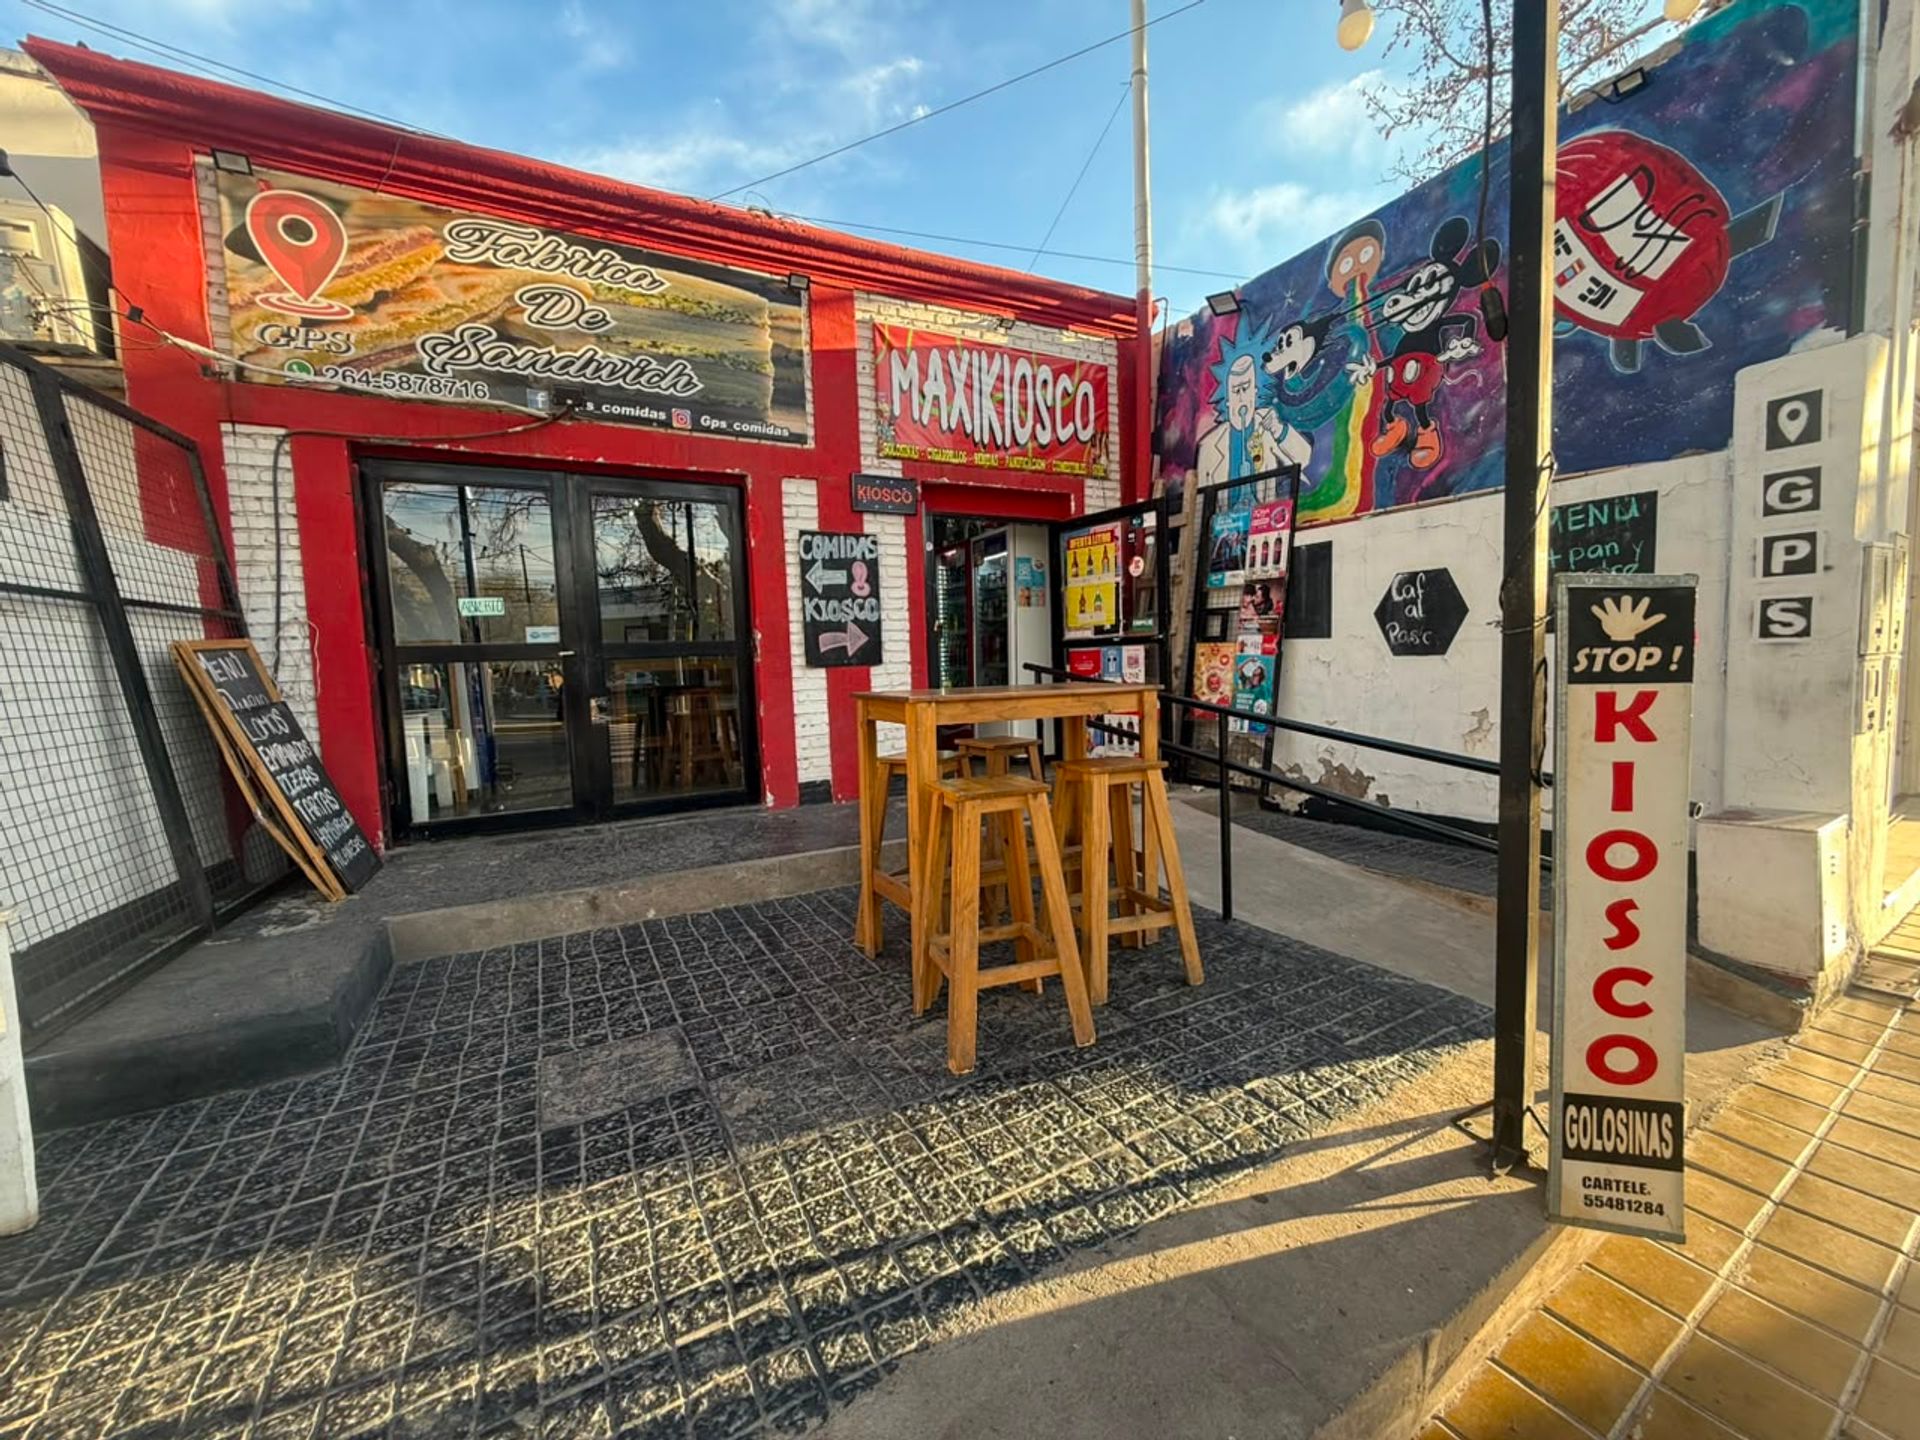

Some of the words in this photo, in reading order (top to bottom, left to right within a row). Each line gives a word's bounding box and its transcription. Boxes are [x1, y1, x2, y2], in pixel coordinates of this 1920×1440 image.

[1578, 164, 1718, 280] Duff
[443, 219, 670, 293] Fabrica
[515, 283, 617, 331] De
[254, 323, 356, 357] GPS
[418, 324, 703, 396] Sandwich
[889, 347, 1096, 449] MAXIKIOSCO
[700, 414, 790, 438] Gps_comidas
[857, 484, 914, 504] KIOSCO
[800, 535, 878, 560] COMIDAS
[1568, 541, 1619, 570] pan
[804, 597, 880, 622] KIOSCO
[1572, 645, 1662, 673] STOP
[292, 787, 340, 825] TARTAS
[1585, 690, 1659, 1086] KIOSCO
[1565, 1104, 1674, 1160] GOLOSINAS
[1583, 1194, 1665, 1216] 55481284
